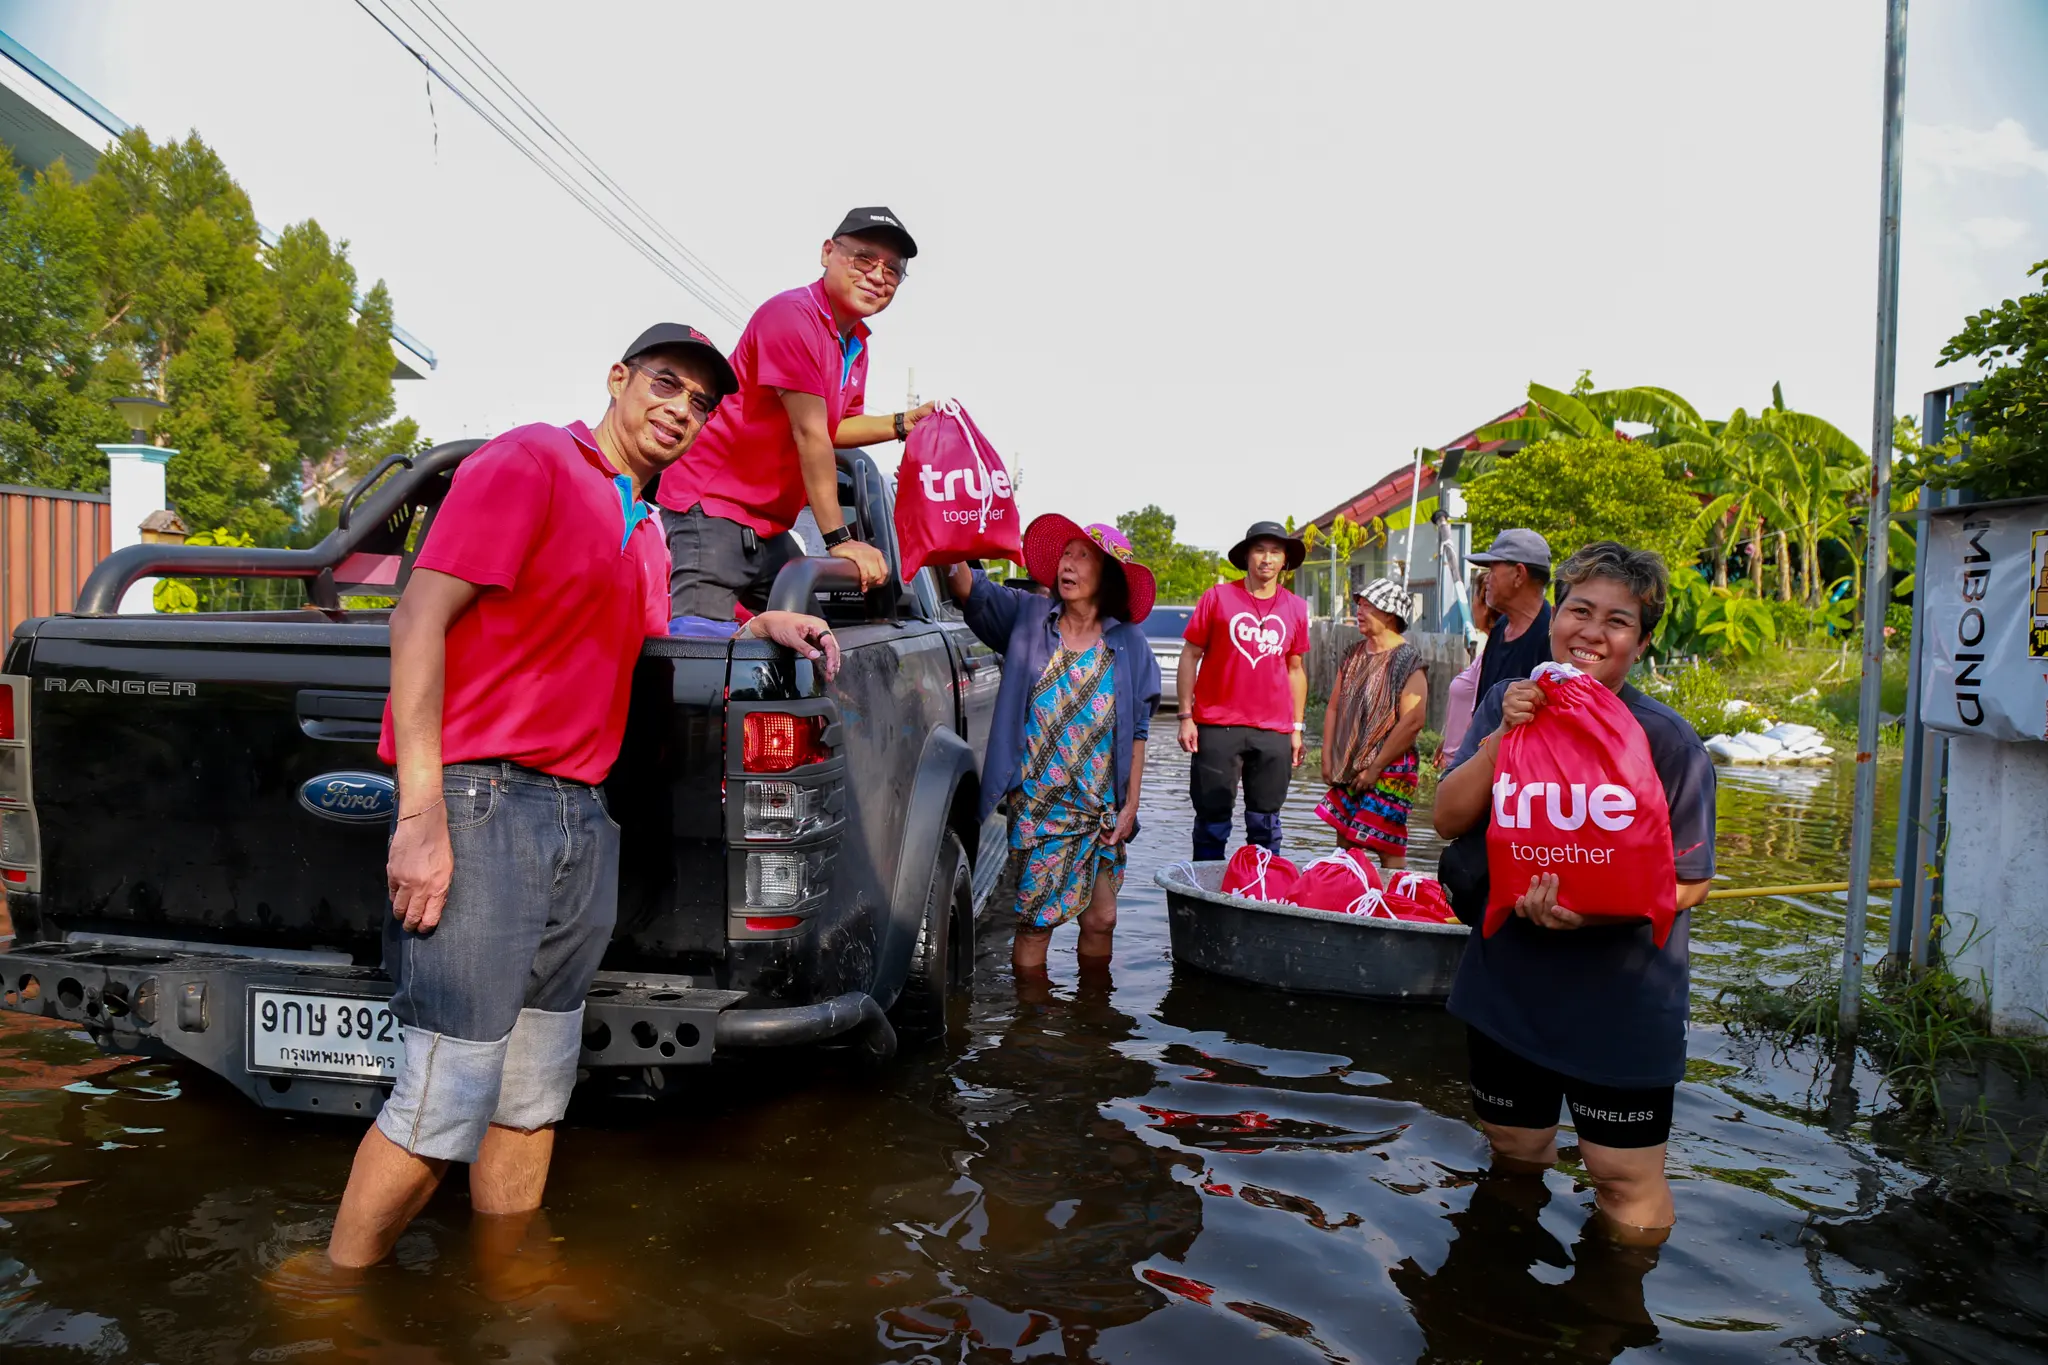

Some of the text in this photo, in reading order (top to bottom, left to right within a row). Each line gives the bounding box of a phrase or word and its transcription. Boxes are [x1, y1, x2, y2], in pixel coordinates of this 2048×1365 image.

[919, 464, 1011, 502] true
[1955, 510, 1992, 727] MBOND
[1237, 622, 1279, 645] true
[44, 677, 197, 697] RANGER
[321, 780, 382, 810] Ford
[1492, 771, 1637, 832] true
[1510, 841, 1616, 867] together
[280, 1046, 396, 1070] กรุงเทพมหานคร
[1572, 1102, 1654, 1122] GENRELESS
